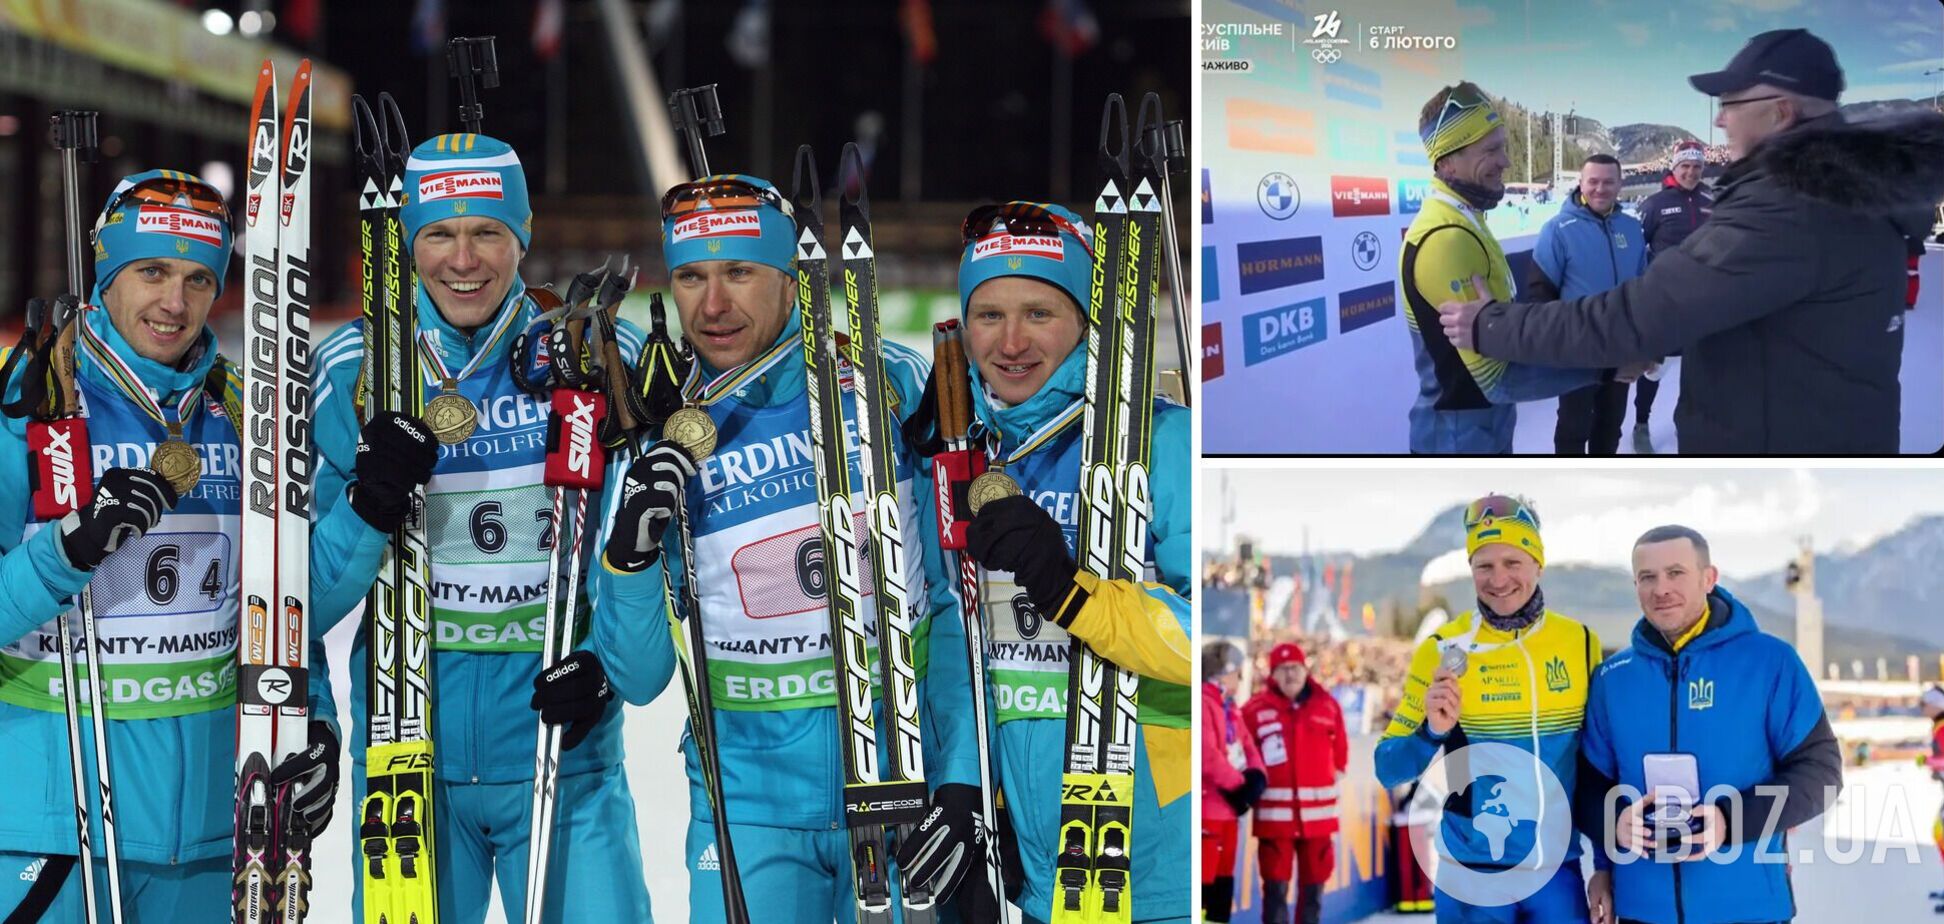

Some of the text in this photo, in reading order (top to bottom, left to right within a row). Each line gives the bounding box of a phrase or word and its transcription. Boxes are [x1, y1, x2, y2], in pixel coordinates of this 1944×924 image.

[420, 177, 501, 195] VIESSMANN
[139, 213, 221, 233] VIESSMANN
[674, 215, 759, 236] VIESSMANN
[974, 236, 1063, 255] VIESSMANN
[362, 219, 373, 317] FISCHER
[388, 217, 400, 316] FISCHER
[1089, 222, 1108, 326] FISCHER
[1123, 220, 1142, 325] FISCHER
[798, 270, 818, 369] FISCHER
[845, 268, 865, 367] FISCHER
[1259, 306, 1314, 343] DKB
[249, 248, 279, 519] ROSSIGNOL
[285, 248, 311, 520] ROSSIGNOL
[393, 416, 426, 443] adidas
[468, 501, 508, 554] 6
[144, 544, 180, 606] 6
[199, 558, 222, 600] 4
[252, 612, 263, 660] WCS
[289, 613, 299, 661] WCS
[545, 660, 580, 683] adidas
[920, 806, 944, 832] adidas
